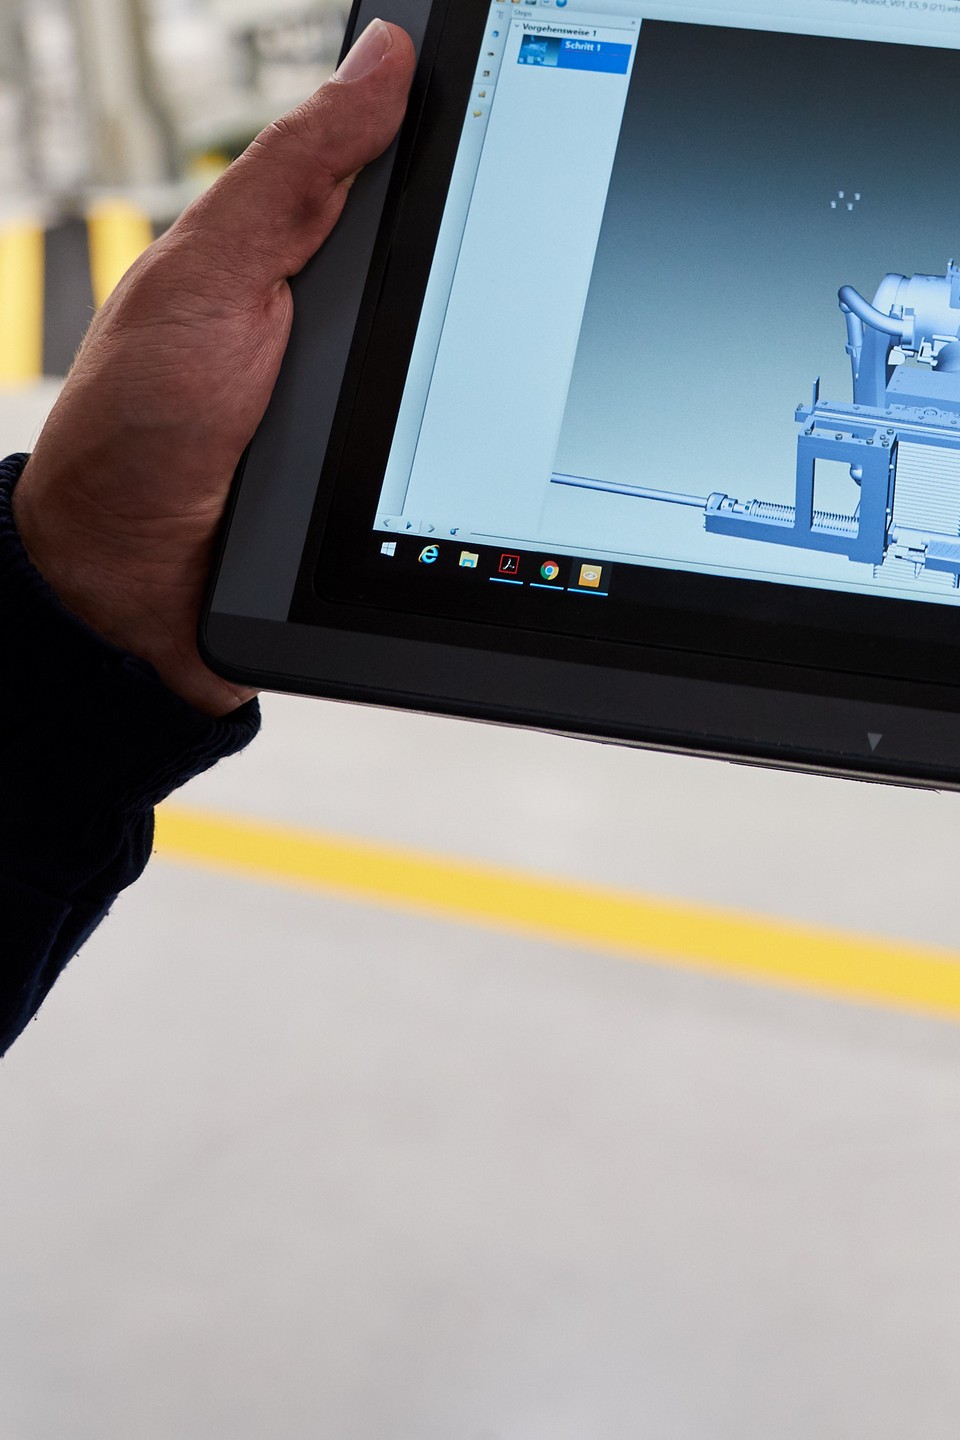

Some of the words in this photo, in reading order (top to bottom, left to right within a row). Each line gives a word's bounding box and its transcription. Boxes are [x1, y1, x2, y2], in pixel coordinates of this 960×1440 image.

[513, 9, 532, 18] Steps
[522, 23, 590, 37] Vorgehensweise
[564, 40, 595, 52] Schritt
